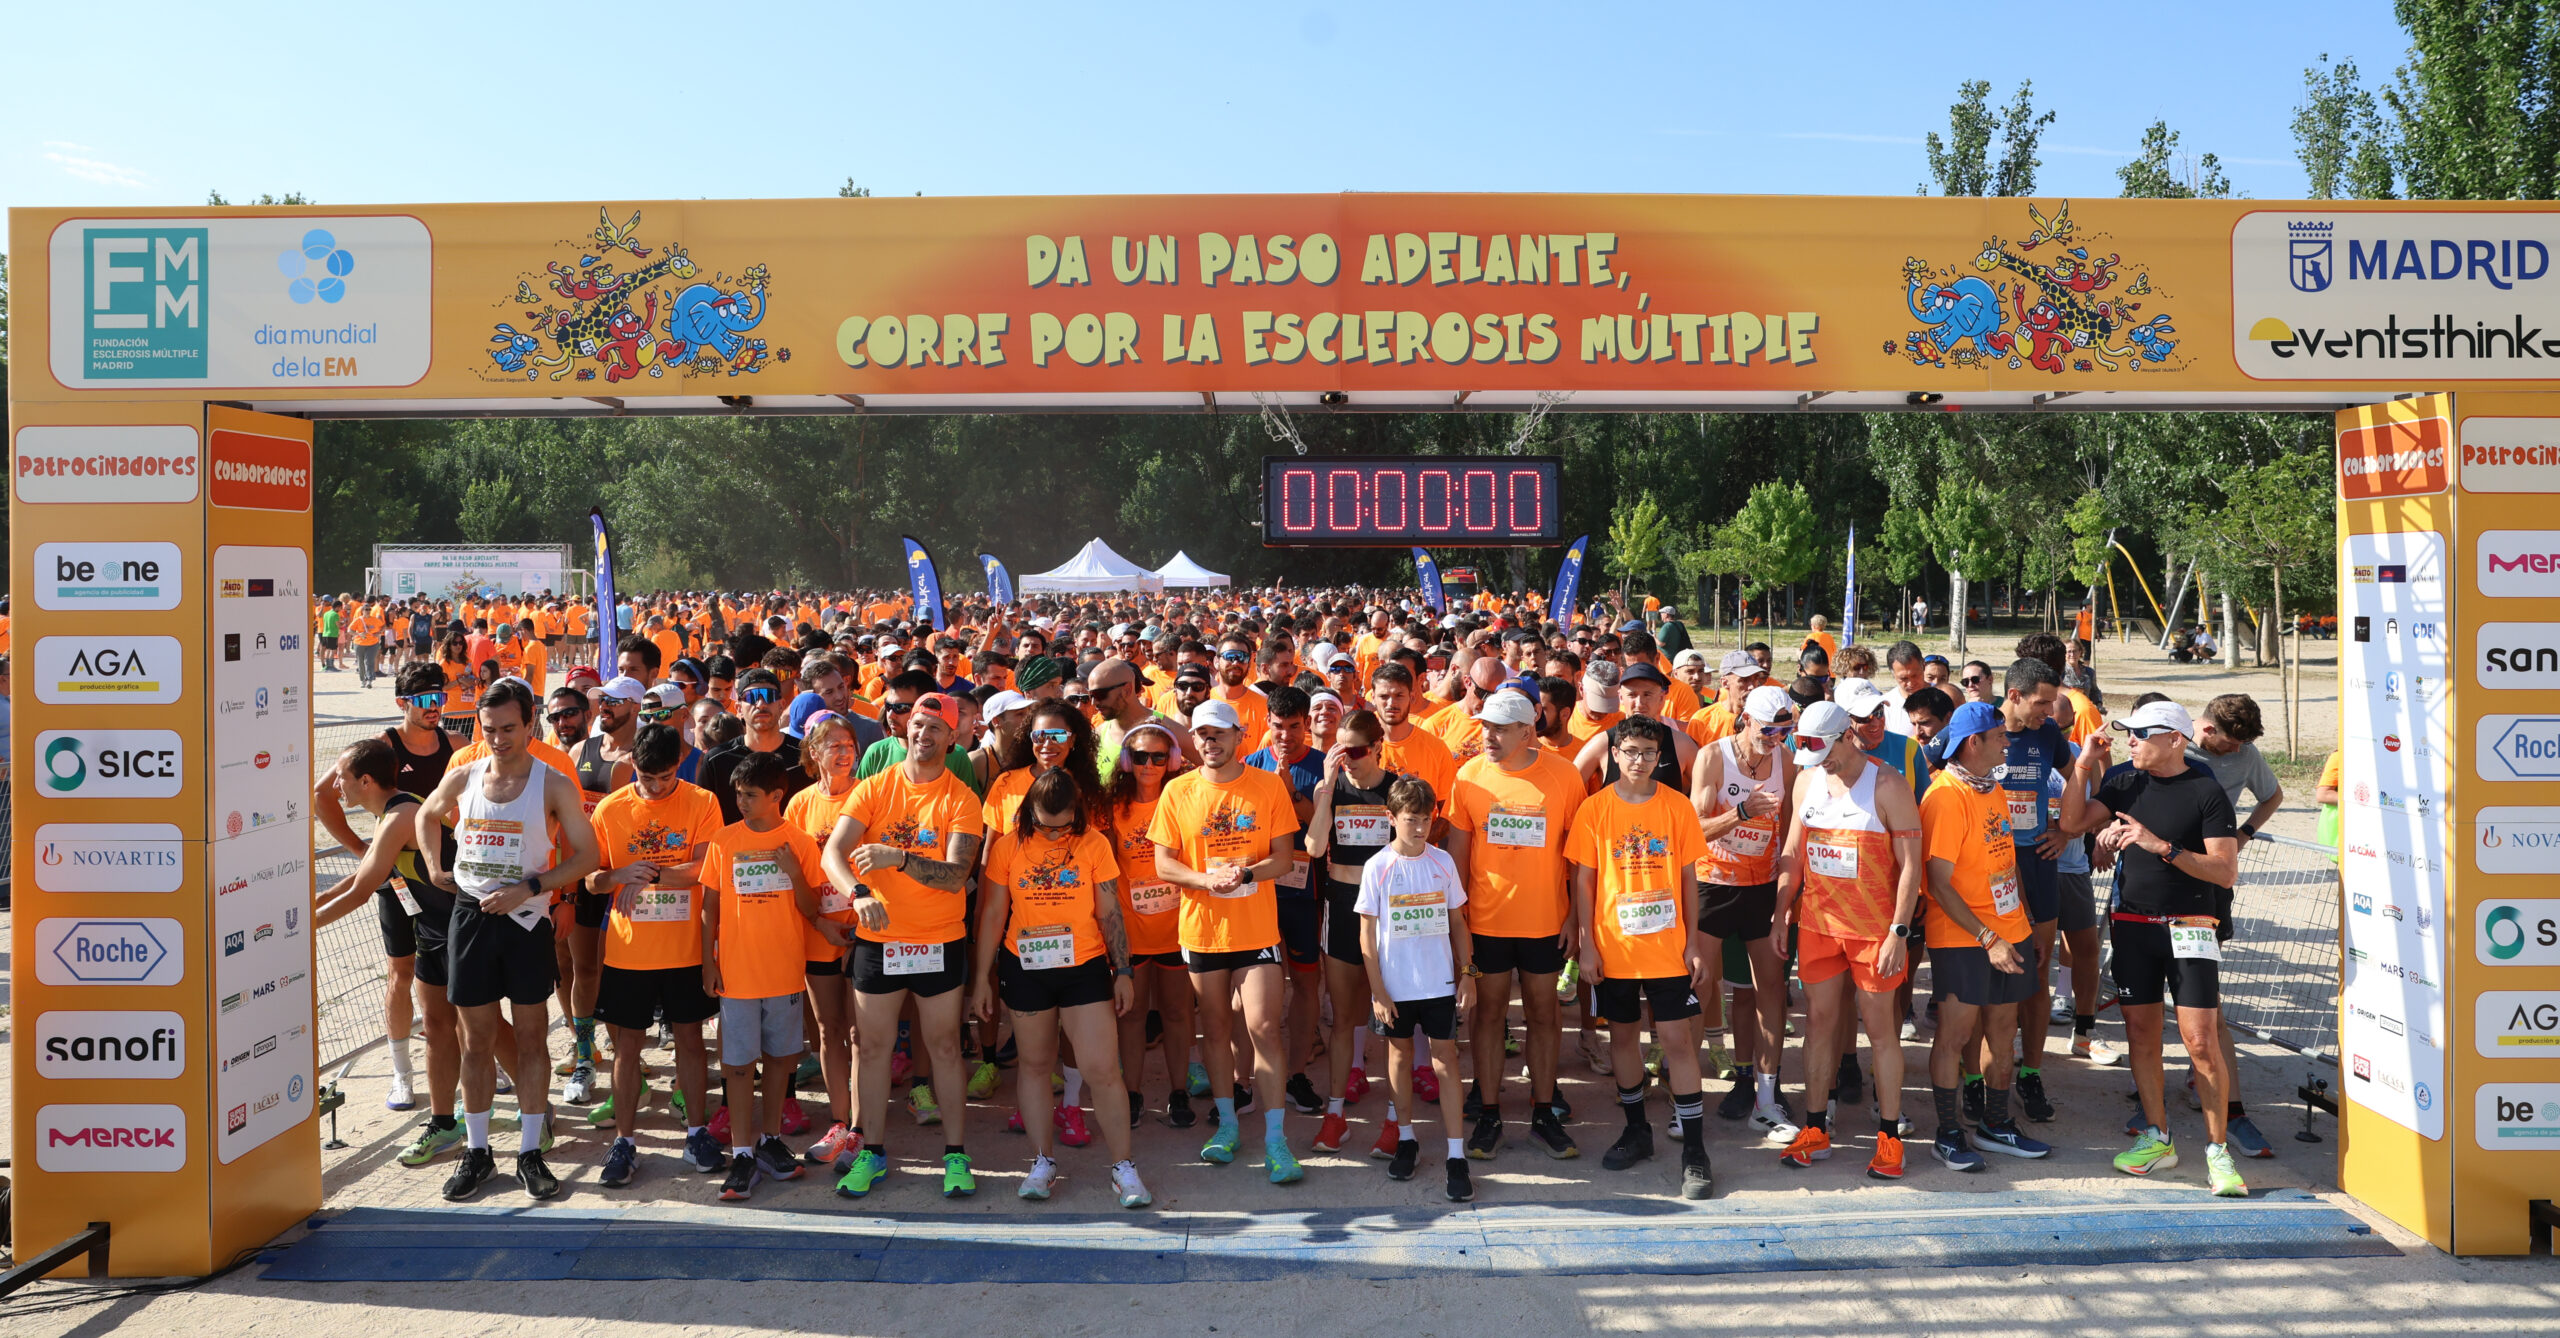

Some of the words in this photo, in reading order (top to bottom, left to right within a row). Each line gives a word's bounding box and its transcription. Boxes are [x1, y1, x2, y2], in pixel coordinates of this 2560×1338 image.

[1026, 233, 1091, 289] DA
[1111, 234, 1179, 287] UN
[1198, 231, 1340, 288] PASO
[1360, 231, 1631, 293] ADELANTE,
[2349, 239, 2550, 290] MADRID
[291, 322, 377, 345] mundial
[836, 312, 1010, 370] CORRE
[1029, 311, 1142, 368] POR
[1162, 313, 1223, 367] LA
[1242, 310, 1561, 367] ESCLEROSIS
[1580, 292, 1819, 367] MÚLTIPLE
[93, 337, 149, 348] FUNDACIÓN
[93, 349, 151, 359] ESCLEROSIS
[152, 347, 199, 359] MÚLTIPLE
[93, 360, 134, 370] MADRID
[1283, 469, 1542, 531] 00:00:00
[69, 648, 146, 677] AGA
[80, 682, 116, 691] producción
[98, 750, 175, 778] SICE
[1348, 819, 1376, 830] 1947
[1501, 817, 1533, 829] 6309
[475, 834, 505, 847] 2128
[1734, 828, 1759, 841] 1045
[73, 850, 176, 866] NOVARTIS
[1817, 846, 1842, 860] 1044
[746, 863, 779, 877] 6290
[646, 893, 677, 905] 5586
[1143, 886, 1172, 899] 6254
[2354, 894, 2371, 909] AQA
[1404, 907, 1434, 920] 6310
[1631, 904, 1662, 918] 5890
[226, 935, 244, 949] AQA
[2187, 930, 2213, 942] 5182
[76, 937, 148, 963] Roche
[899, 944, 929, 956] 1970
[1028, 939, 1060, 953] 5844
[2380, 961, 2405, 978] MARS
[253, 980, 276, 1000] MARS
[46, 1028, 176, 1062] sanofi
